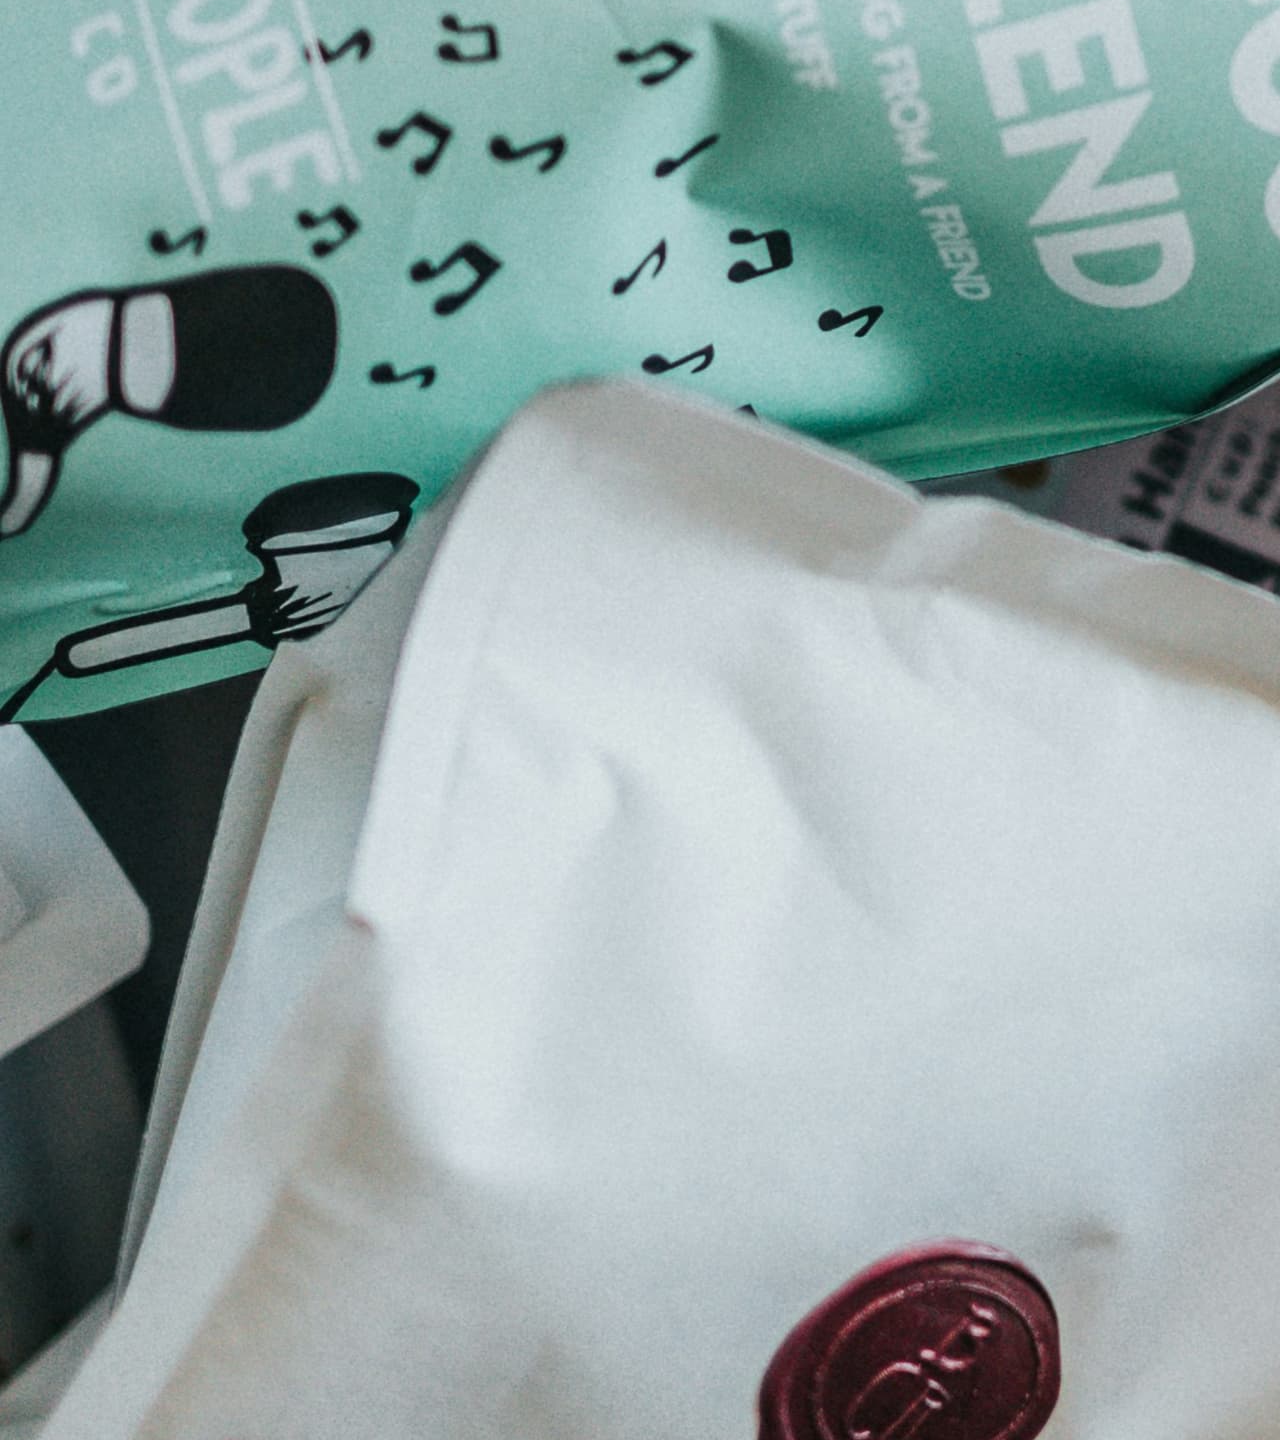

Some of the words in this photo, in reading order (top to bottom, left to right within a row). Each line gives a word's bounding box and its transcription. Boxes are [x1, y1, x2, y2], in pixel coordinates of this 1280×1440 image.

[69, 13, 138, 107] CO
[871, 44, 938, 174] FROM
[908, 167, 947, 202] A
[919, 200, 992, 302] FRIEND
